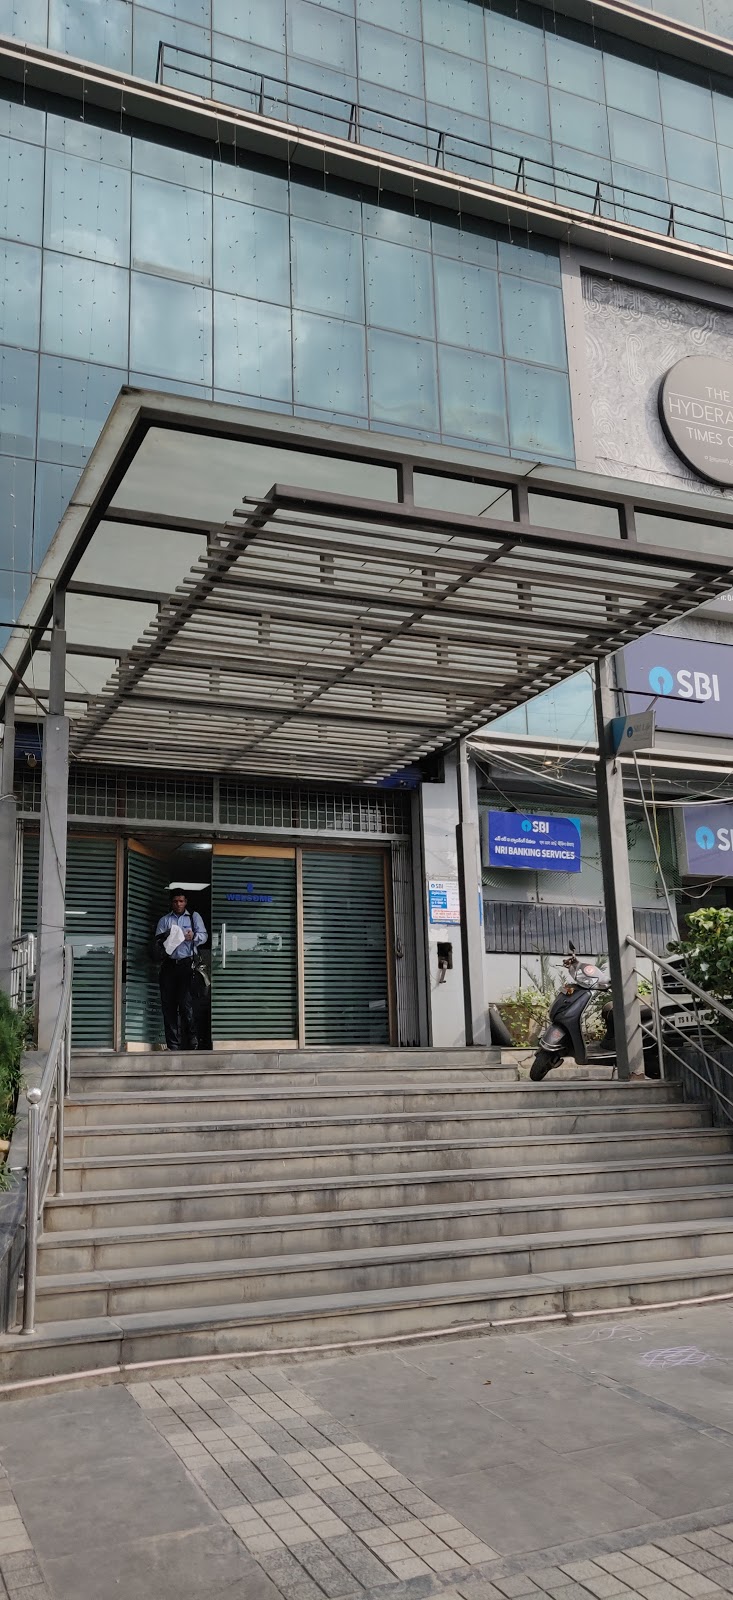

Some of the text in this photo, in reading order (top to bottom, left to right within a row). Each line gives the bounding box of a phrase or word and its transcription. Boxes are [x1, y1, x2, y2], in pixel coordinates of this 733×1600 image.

[705, 386, 731, 402] THE
[685, 426, 723, 446] TIMES
[676, 669, 720, 702] SBI
[532, 820, 549, 833] SBI
[716, 827, 733, 851] S
[494, 845, 575, 860] NRI BANKING SERVICES
